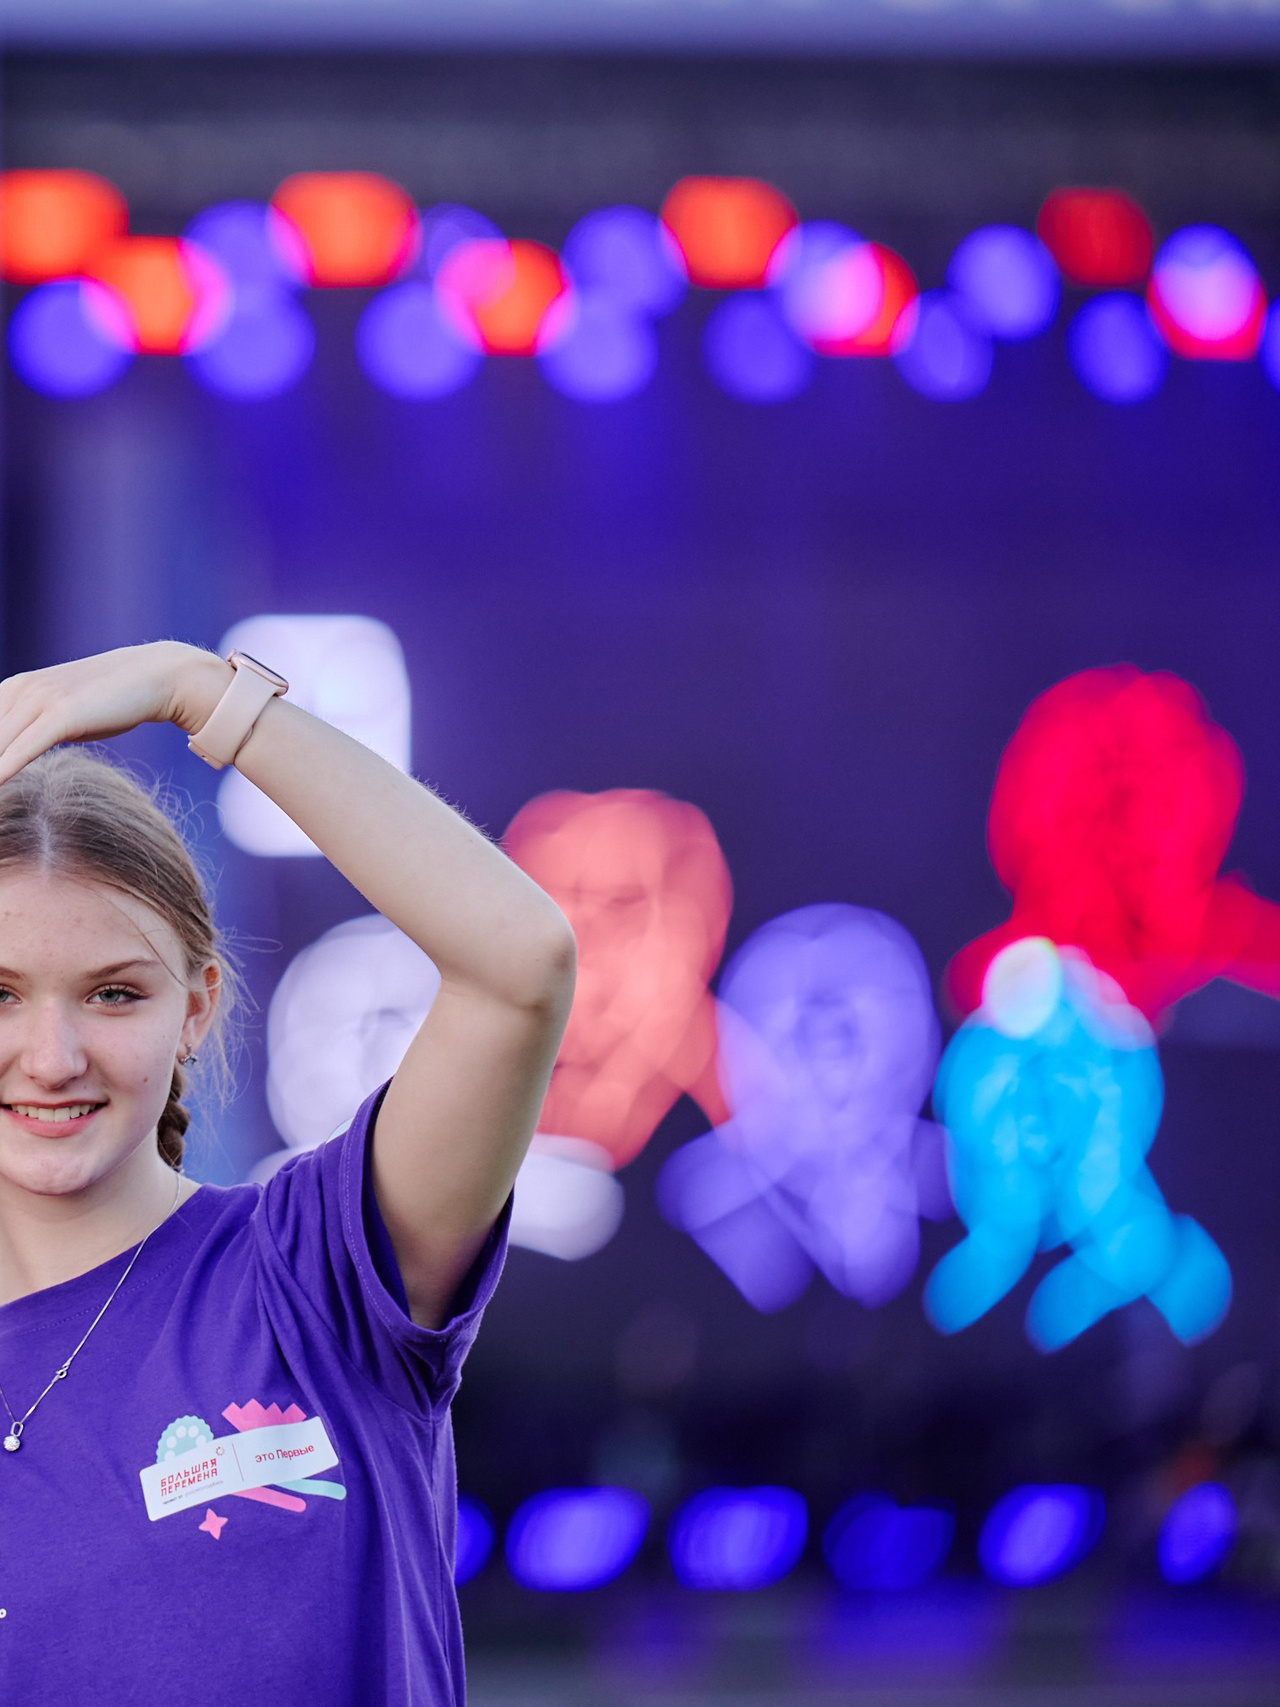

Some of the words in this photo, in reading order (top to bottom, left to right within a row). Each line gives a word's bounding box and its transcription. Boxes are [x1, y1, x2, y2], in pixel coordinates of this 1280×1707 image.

[254, 1453, 275, 1463] это
[276, 1444, 315, 1461] Первые
[160, 1458, 217, 1488] БОЛЬШАЯ
[160, 1468, 218, 1497] ПЕРЕМЕНА
